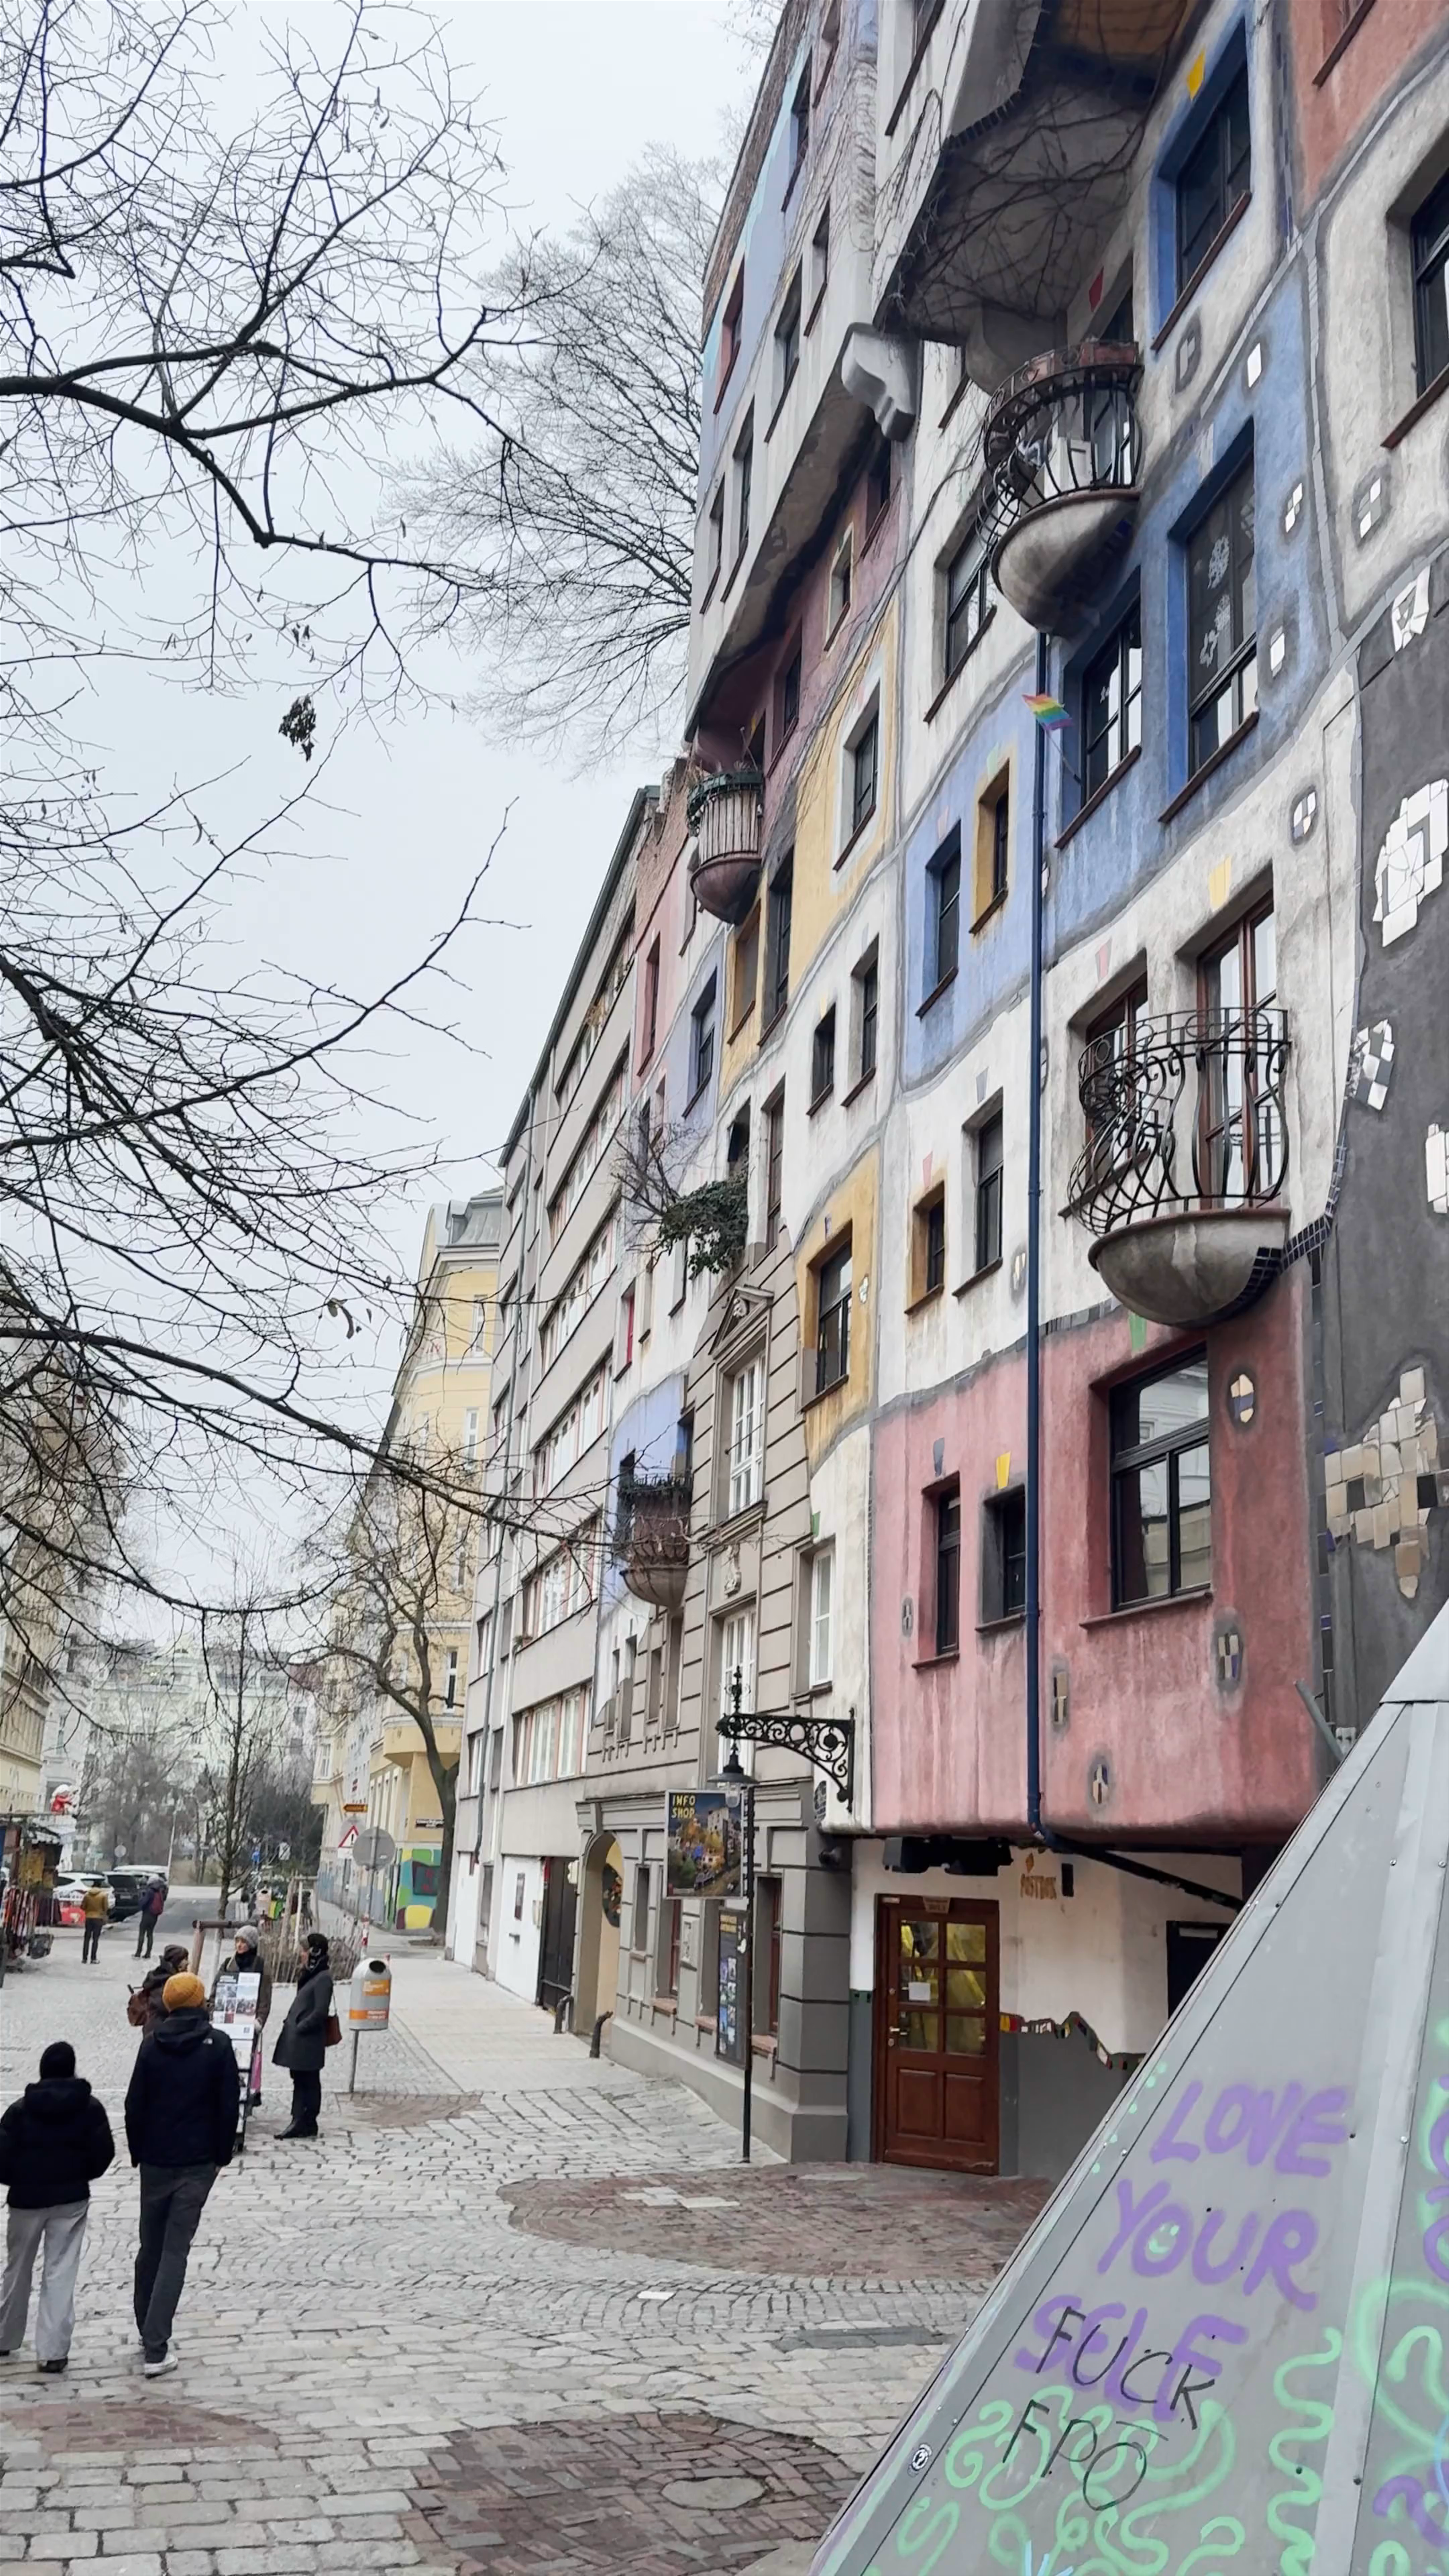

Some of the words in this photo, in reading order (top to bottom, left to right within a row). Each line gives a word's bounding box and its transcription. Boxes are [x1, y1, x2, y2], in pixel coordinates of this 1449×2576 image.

[671, 1807, 695, 1818] SHOP
[672, 1795, 695, 1806] INFO
[1149, 2080, 1348, 2178] LOVE
[1097, 2178, 1318, 2311] YOUR
[1014, 2295, 1248, 2421] SELF
[1035, 2305, 1215, 2430] FUCK
